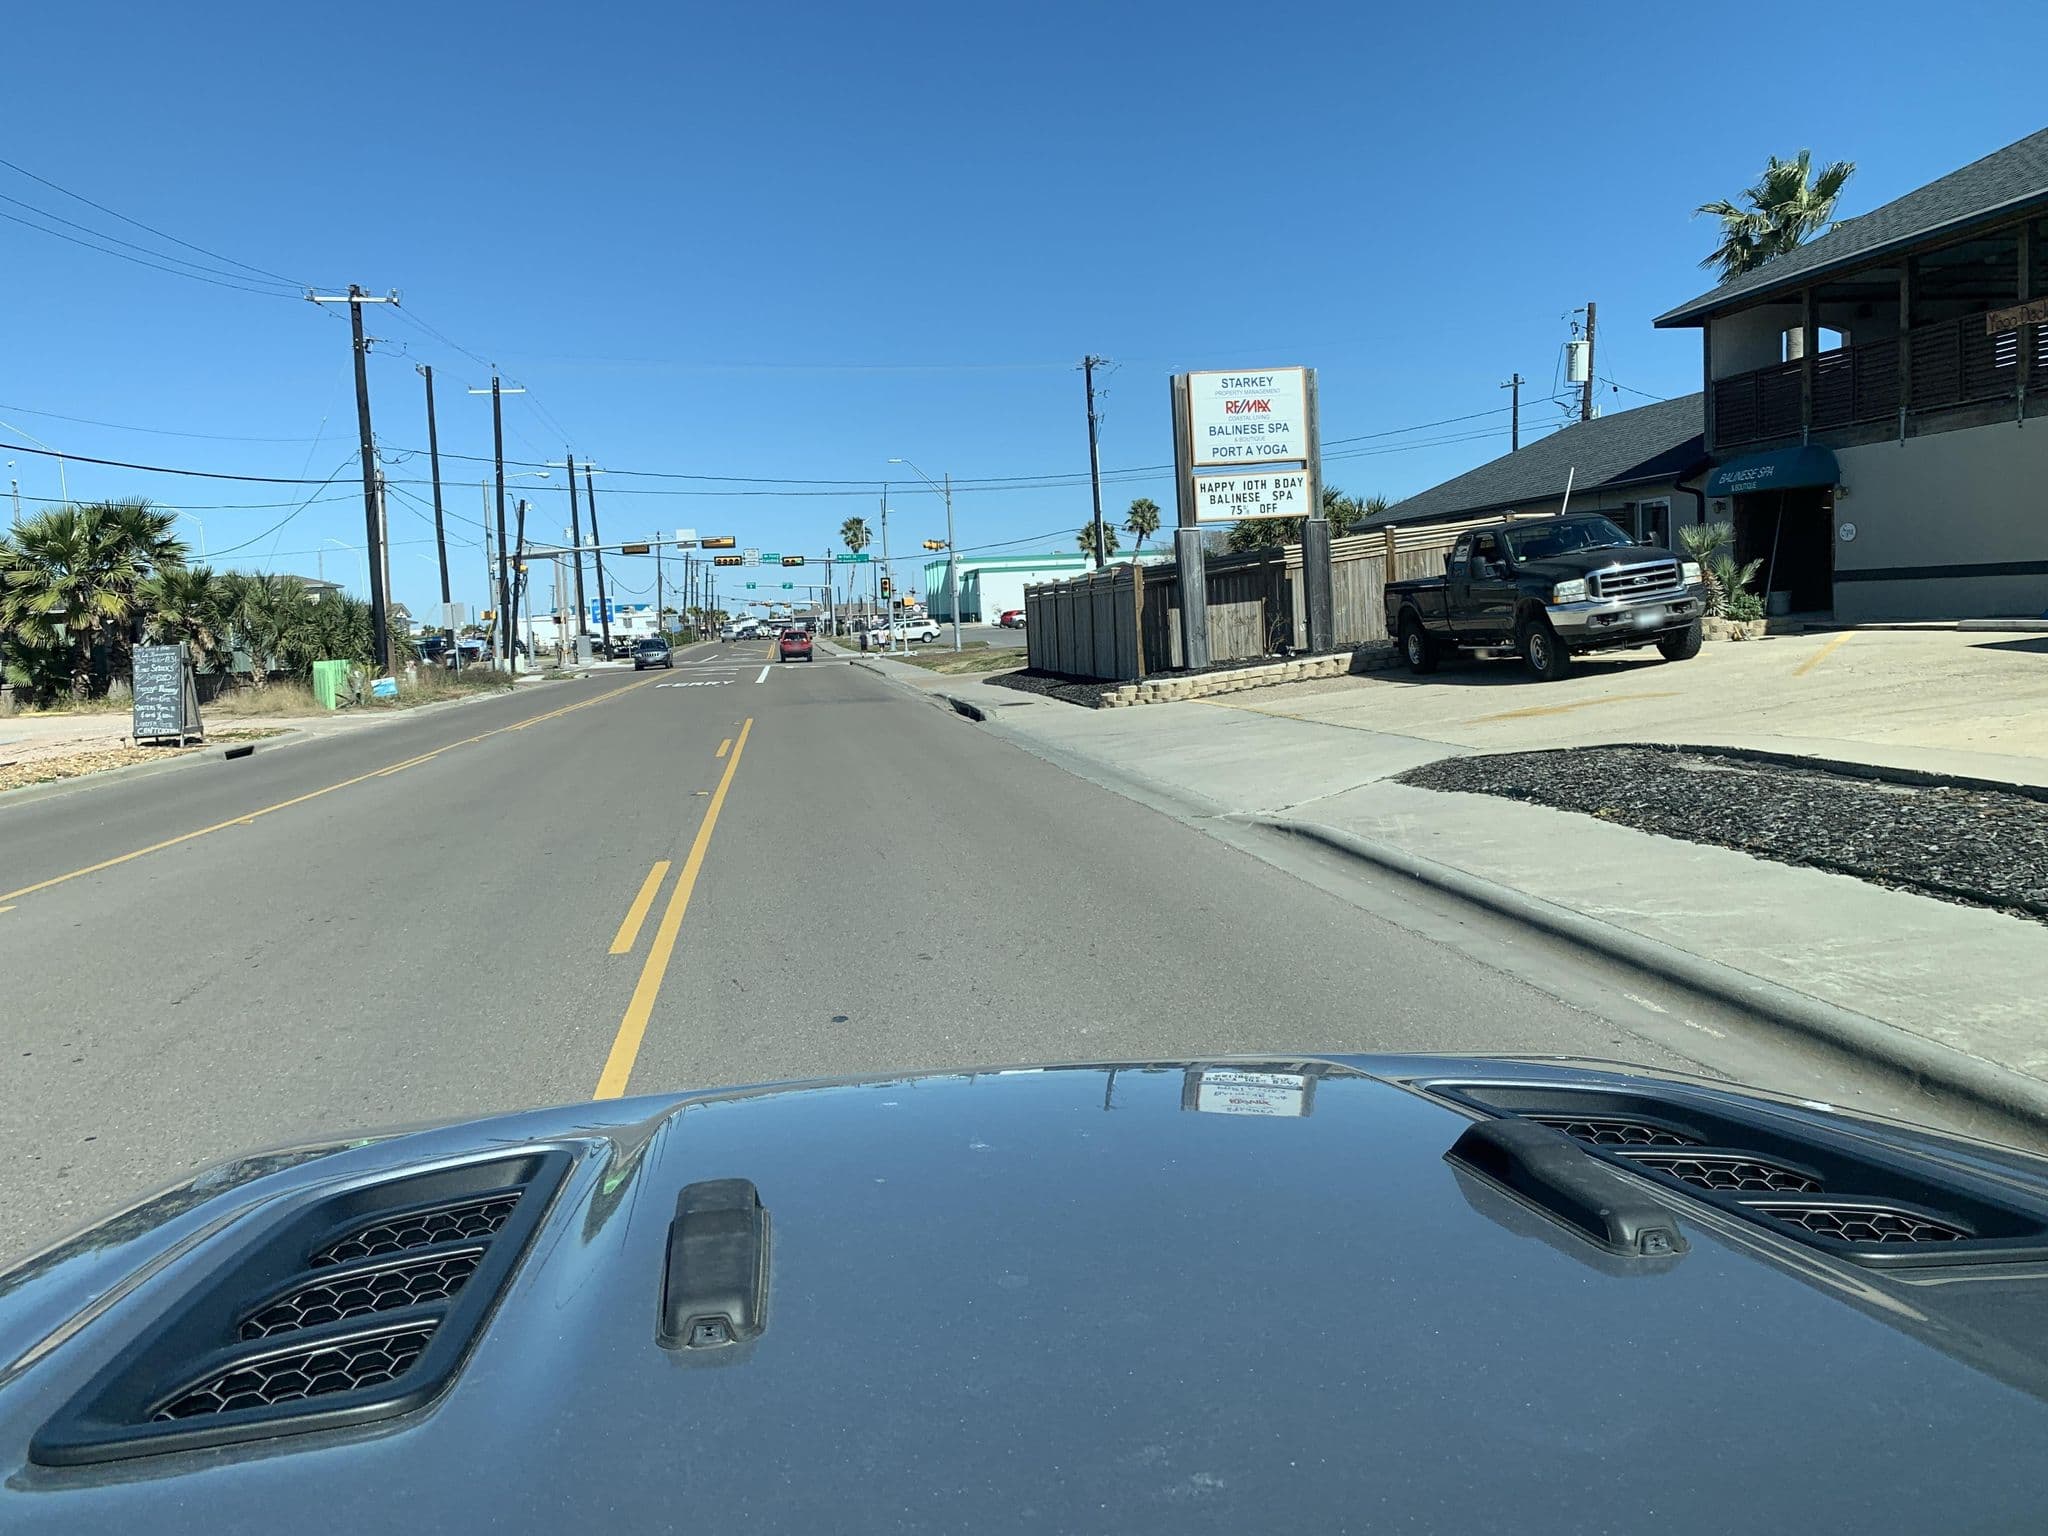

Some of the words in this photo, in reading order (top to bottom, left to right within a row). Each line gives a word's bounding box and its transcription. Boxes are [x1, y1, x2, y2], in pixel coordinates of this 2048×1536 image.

[1221, 376, 1274, 388] STARKEY
[1225, 399, 1271, 414] RE/MAX
[1209, 423, 1265, 436] BALINESE
[1268, 422, 1290, 433] SPA
[1212, 446, 1242, 457] PORT
[1245, 446, 1254, 456] A
[1256, 444, 1288, 455] YOGA
[1719, 468, 1758, 484] BALINESE
[1757, 466, 1775, 478] SPA
[1200, 481, 1235, 493] HAPPY
[1243, 479, 1267, 491] 10TH
[1209, 492, 1260, 504] BALINESE
[1272, 490, 1293, 501] SPA
[1260, 503, 1278, 513] OFF
